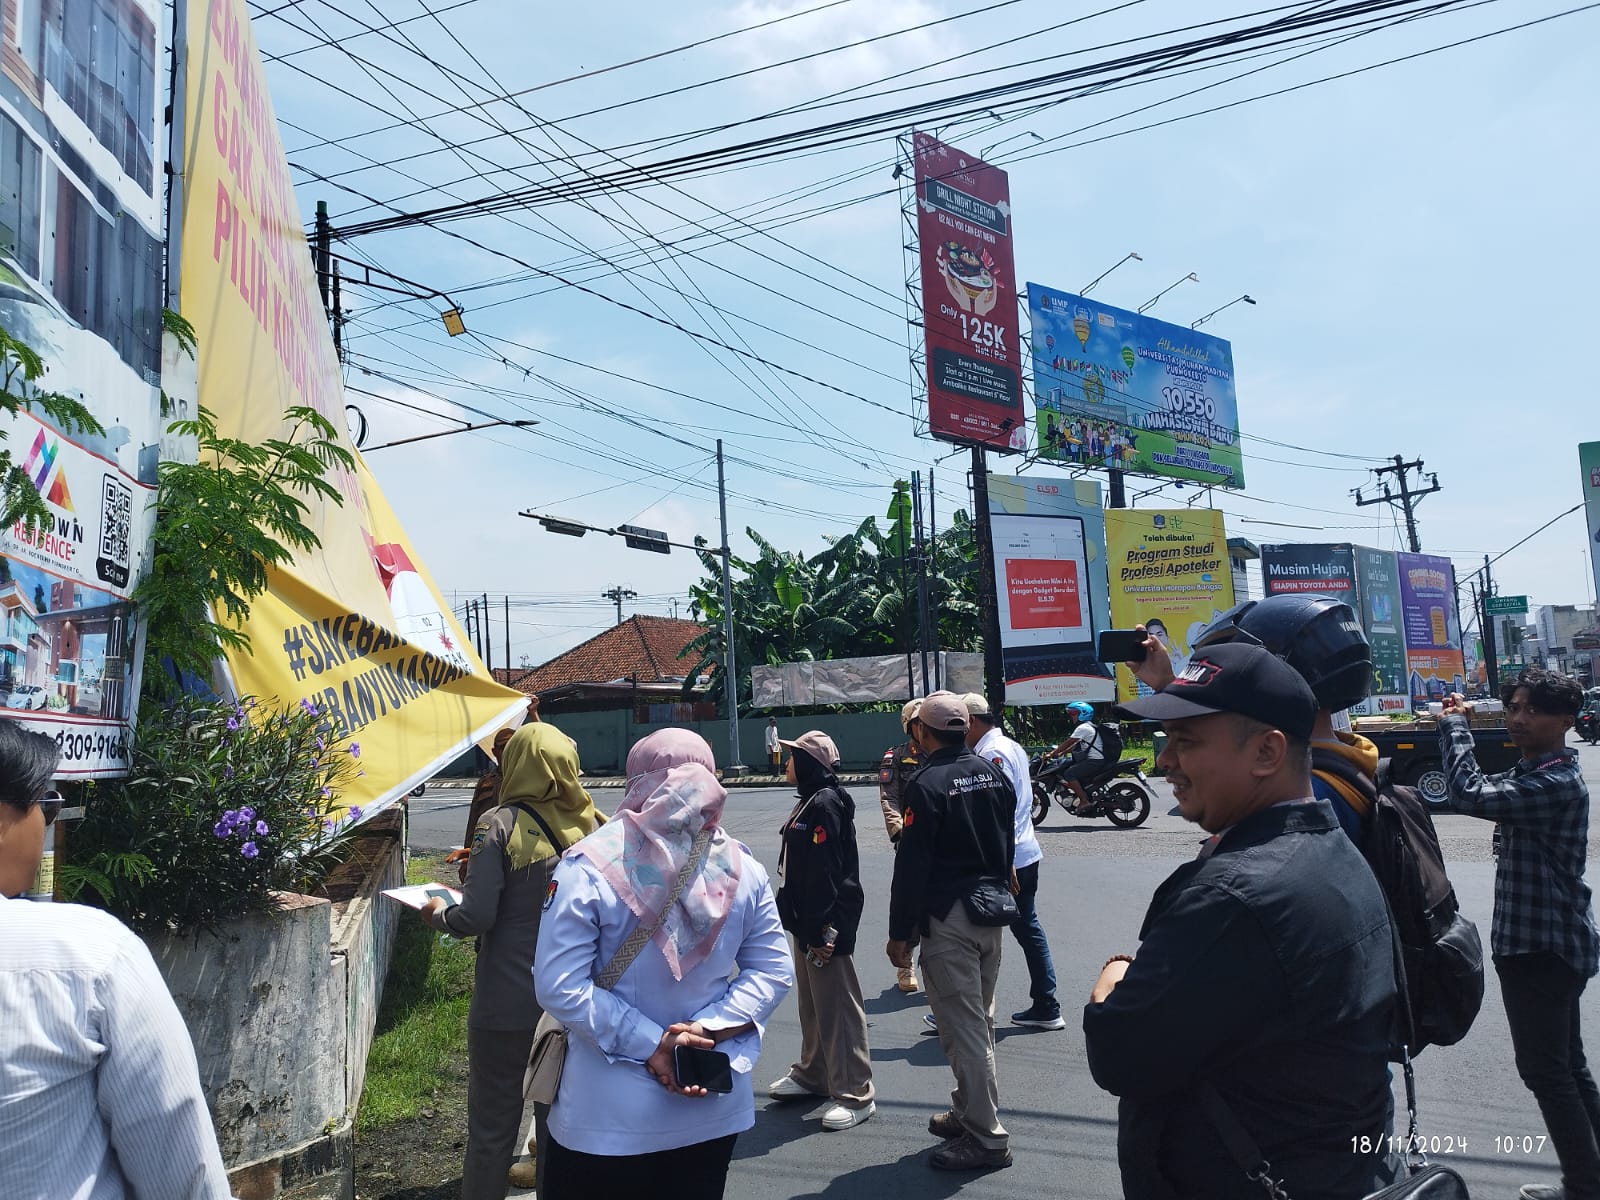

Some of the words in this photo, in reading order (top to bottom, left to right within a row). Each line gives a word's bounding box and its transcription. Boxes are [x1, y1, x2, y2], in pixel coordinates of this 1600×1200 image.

[214, 70, 254, 217] GAK
[936, 185, 954, 203] GRILL
[954, 193, 972, 211] NIGHT
[972, 201, 996, 221] STATION
[946, 216, 954, 228] ALL
[955, 219, 964, 231] YOU
[964, 224, 974, 235] CAN
[974, 228, 983, 238] EAT
[983, 231, 996, 244] MENU
[213, 177, 268, 334] PILIH
[940, 303, 958, 319] Only
[1051, 297, 1069, 308] UMP
[960, 313, 1007, 351] 125K
[1137, 346, 1179, 366] UNIVERSITAS
[945, 366, 957, 375] Start
[958, 358, 972, 368] Every
[972, 362, 994, 375] Thursday
[1166, 363, 1207, 383] PURWOKERTO
[1146, 411, 1209, 437] MAHASISWA
[1209, 423, 1234, 446] BARU
[1165, 534, 1195, 542] dibuka!
[1126, 548, 1181, 564] Program
[1183, 542, 1215, 557] Studi
[1121, 562, 1164, 581] Profesi
[1165, 558, 1222, 577] Apoteker
[1269, 563, 1310, 575] Musim
[1311, 563, 1350, 577] Hujan,
[1124, 584, 1164, 593] Universitas
[1355, 704, 1366, 713] 555
[953, 773, 993, 788] PANWASLU
